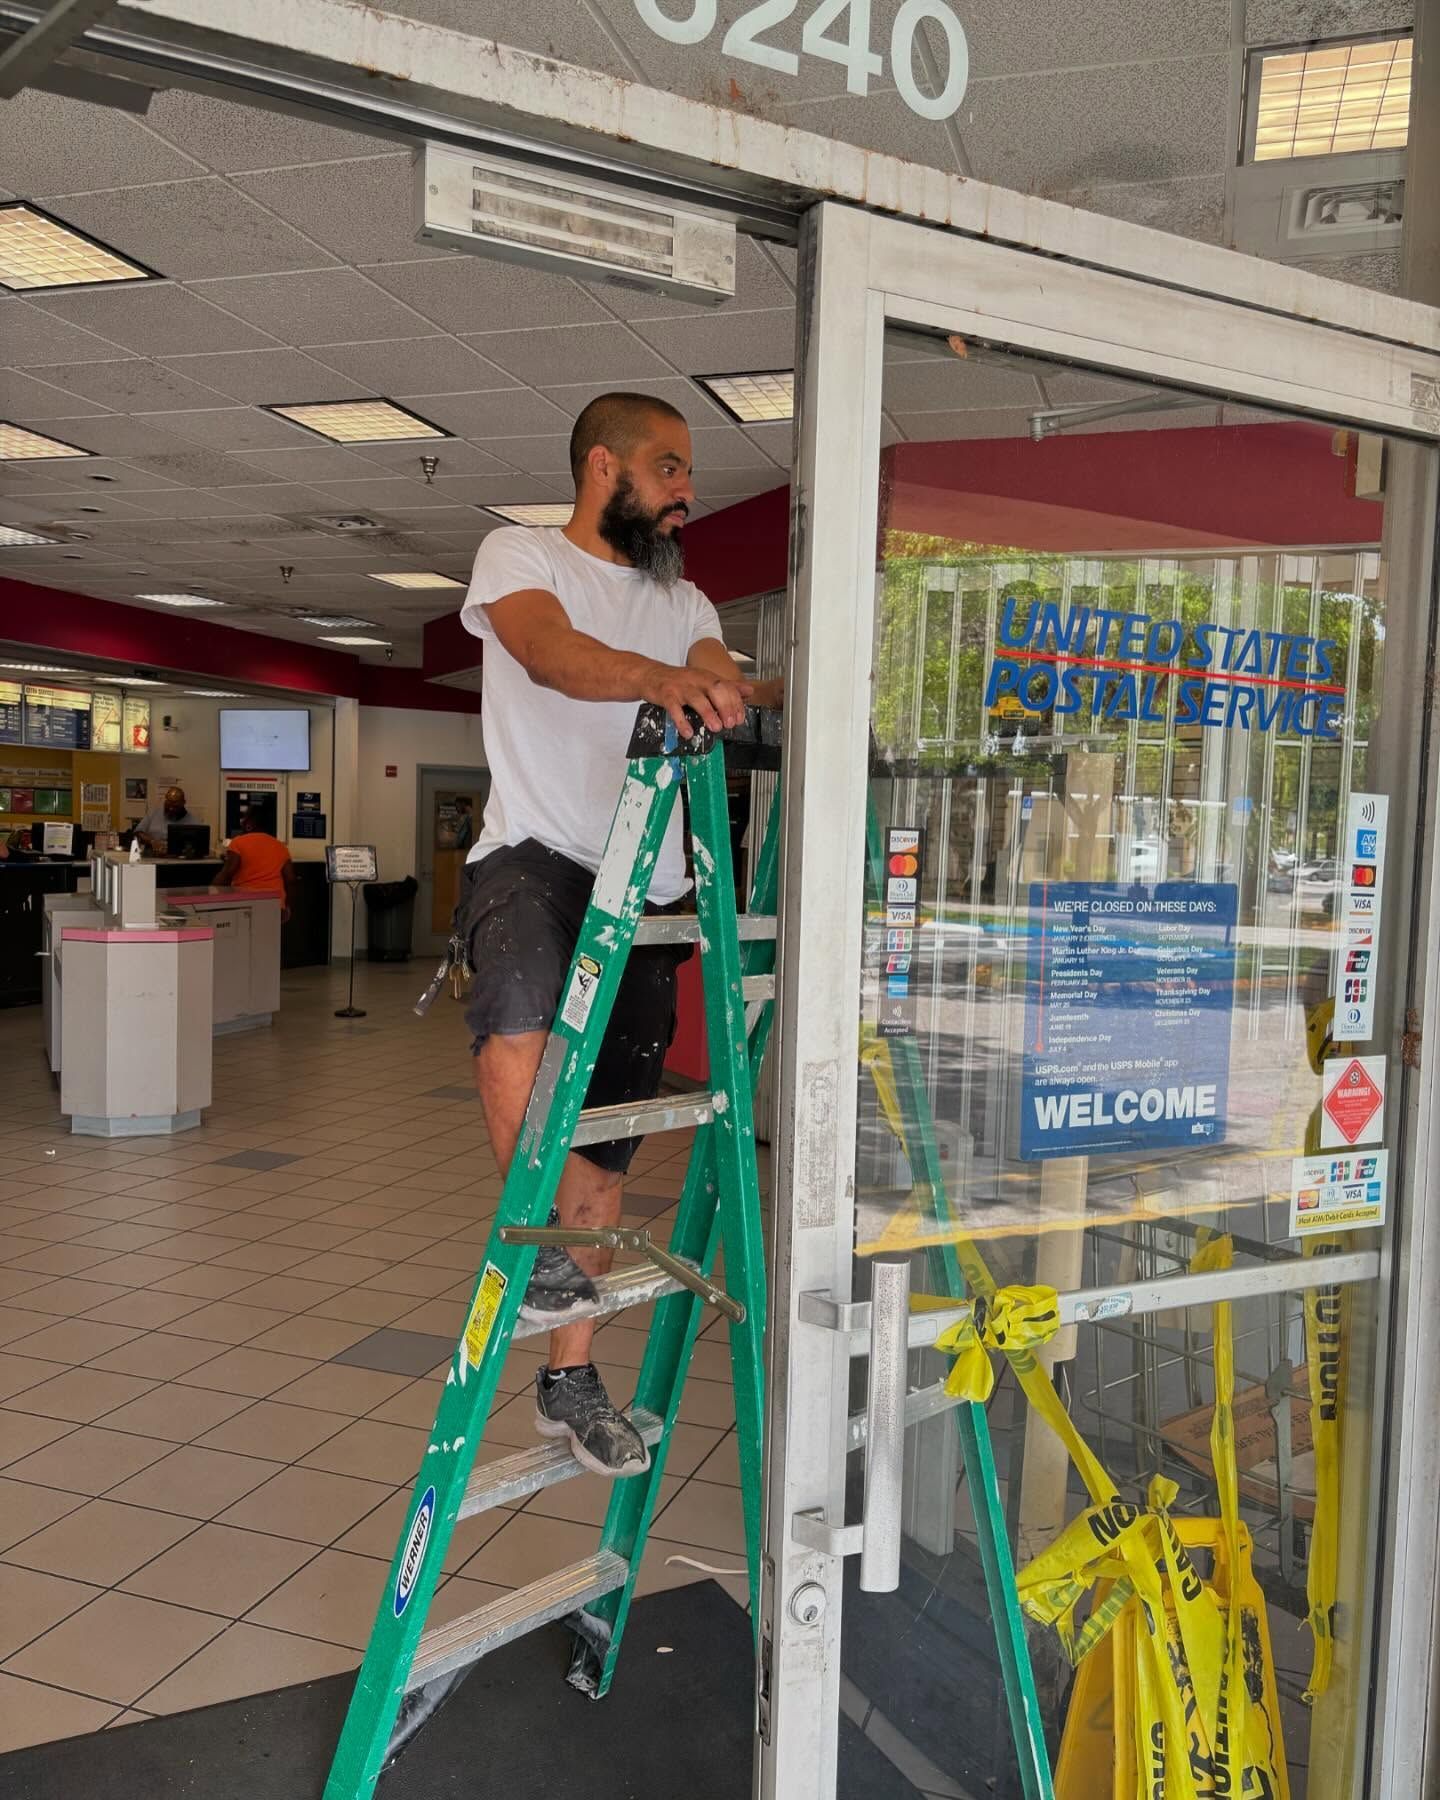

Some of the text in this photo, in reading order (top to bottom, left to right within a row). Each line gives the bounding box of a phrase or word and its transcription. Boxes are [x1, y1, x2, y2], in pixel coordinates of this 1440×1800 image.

[1000, 598, 1336, 680] UNITED STATES
[985, 659, 1345, 737] POSTAL SERVICE
[1054, 901, 1216, 912] WE'RE CLOSED ON THESE DAYS:
[1354, 899, 1371, 909] VISA
[892, 912, 912, 920] VISA
[1093, 925, 1106, 933] Day
[1100, 946, 1117, 955] King
[1191, 945, 1203, 953] Day
[1051, 969, 1103, 977] Presidents Day
[1186, 967, 1198, 975] Day
[1051, 991, 1098, 999] Memorial Day
[1156, 987, 1211, 997] Thanksgiving Day
[1155, 1008, 1200, 1017] Christmas Day
[884, 1027, 909, 1035] Accepted
[1049, 1034, 1112, 1044] Independence Day
[1082, 1063, 1096, 1072] and
[1098, 1062, 1109, 1071] the
[1111, 1060, 1133, 1070] USPS
[1164, 1060, 1178, 1069] app
[1035, 1076, 1097, 1089] are always open.
[1034, 1084, 1217, 1130] WELCOME
[1345, 1190, 1362, 1199] VISA
[1340, 1212, 1354, 1220] Cards
[1356, 1208, 1378, 1217] Accepted
[1312, 1243, 1344, 1420] CUTION
[401, 1511, 428, 1591] WERNER
